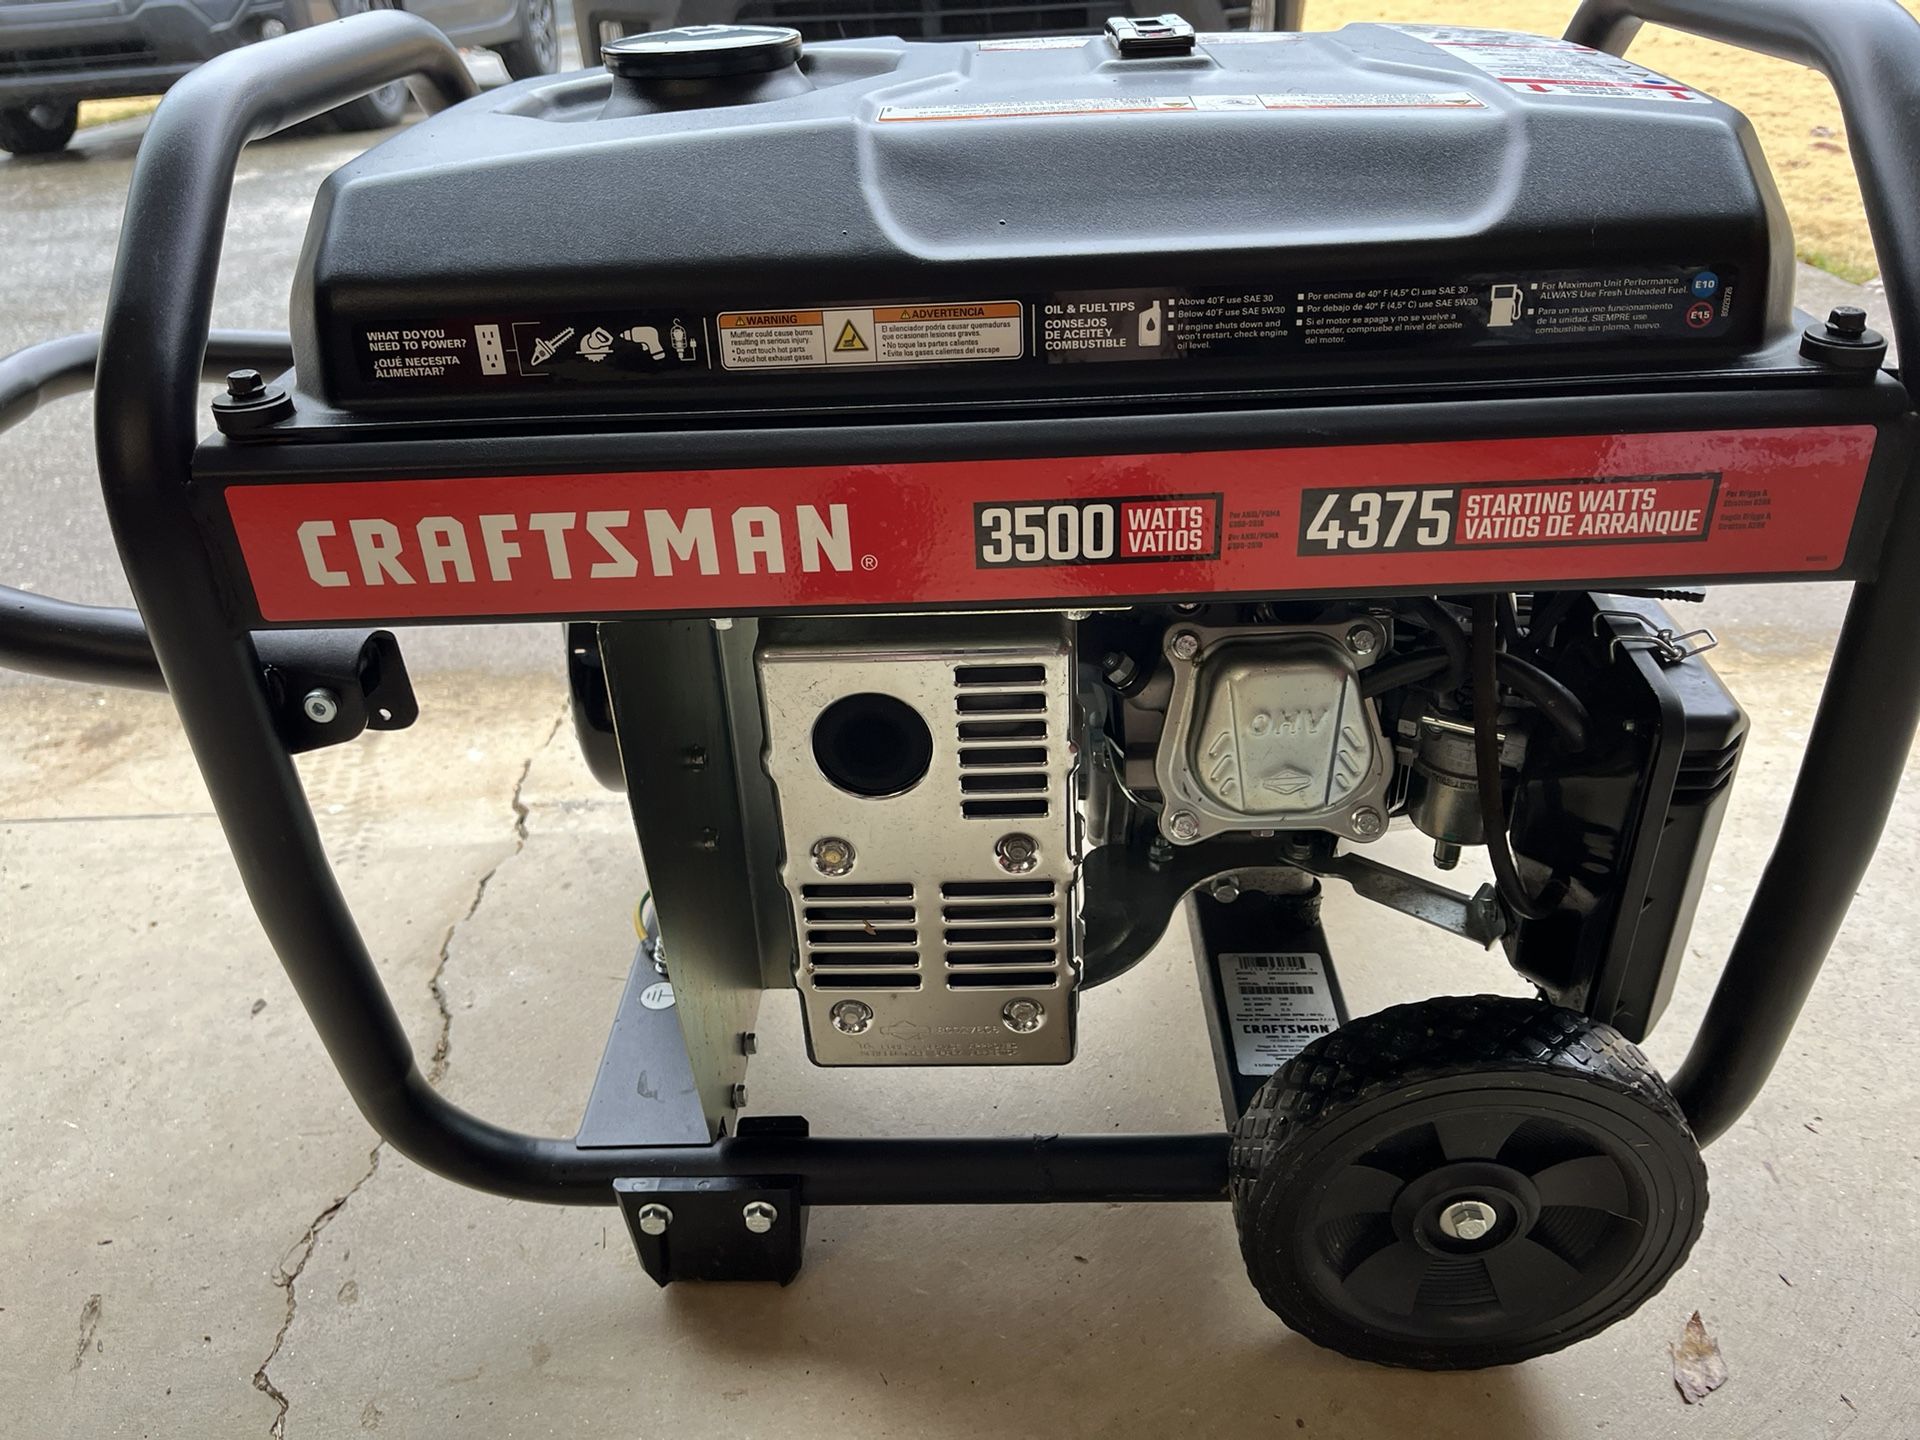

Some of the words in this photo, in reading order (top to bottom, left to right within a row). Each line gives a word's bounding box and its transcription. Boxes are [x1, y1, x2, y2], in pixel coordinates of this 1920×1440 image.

[1541, 282, 1556, 290] For
[1558, 281, 1602, 289] Maximum
[1604, 279, 1622, 288] Unit
[1624, 278, 1680, 286] Performance
[1695, 280, 1715, 289] E10
[1308, 292, 1322, 300] Por
[1324, 292, 1354, 300] encima
[1422, 288, 1437, 296] use
[1438, 287, 1456, 295] SAE
[1458, 286, 1468, 294] 30
[1540, 291, 1578, 300] ALWAYS
[1580, 290, 1597, 298] Use
[1598, 289, 1623, 298] Fresh
[1624, 287, 1666, 296] Unleaded
[1178, 298, 1205, 306] Above
[1244, 294, 1262, 303] SAE
[1264, 294, 1274, 302] 30
[1307, 305, 1321, 313] Por
[1323, 304, 1351, 313] debajo
[1454, 298, 1478, 306] 5W30
[912, 306, 985, 319] ADVERTENCIA
[1045, 305, 1064, 314] OIL
[1066, 304, 1076, 314] &
[1080, 304, 1108, 313] FUEL
[1109, 302, 1136, 312] TIPS
[1178, 310, 1204, 318] Below
[1242, 307, 1259, 315] SAE
[1261, 306, 1286, 314] 5W30
[746, 315, 798, 326] WARNING
[1045, 318, 1108, 329] CONSEJOS
[1306, 318, 1314, 326] Si
[1364, 316, 1388, 324] apaga
[1422, 312, 1449, 320] vuelve
[889, 324, 924, 332] silenciador
[970, 322, 1011, 330] quemaduras
[1186, 324, 1214, 332] engine
[1215, 322, 1238, 330] shuts
[1240, 321, 1263, 329] down
[1265, 320, 1280, 328] and
[366, 330, 400, 341] WHAT
[882, 334, 894, 342] que
[896, 332, 928, 340] ocasionen
[1045, 330, 1060, 340] DE
[1063, 329, 1104, 339] ACEITE
[1105, 328, 1113, 337] Y
[1234, 330, 1258, 338] check
[1260, 329, 1288, 338] engine
[369, 342, 400, 352] NEED
[402, 341, 418, 350] TO
[421, 338, 467, 350] POWER?
[917, 340, 926, 348] las
[928, 340, 948, 348] partes
[1045, 338, 1127, 350] COMBUSTIBLE
[1177, 342, 1188, 350] oil
[1305, 336, 1318, 344] del
[914, 350, 934, 358] gases
[935, 348, 964, 356] calientes
[977, 346, 1000, 354] escape
[374, 356, 402, 370] ¿QUÉ
[406, 356, 460, 366] NECESITA
[376, 367, 445, 378] ALIMENTAR?
[1466, 491, 1572, 518] STARTING
[1577, 487, 1658, 513] WATTS
[1128, 506, 1203, 531] WATTS
[1304, 488, 1455, 550] 4375
[1465, 514, 1540, 540] VATIOS
[1545, 513, 1573, 537] DE
[1577, 508, 1700, 535] ARRANQUE
[981, 503, 1115, 564] 3500
[1128, 530, 1203, 554] VATIOS
[1249, 710, 1331, 736] OHV
[1243, 1024, 1330, 1034] CRAFTSMAN
